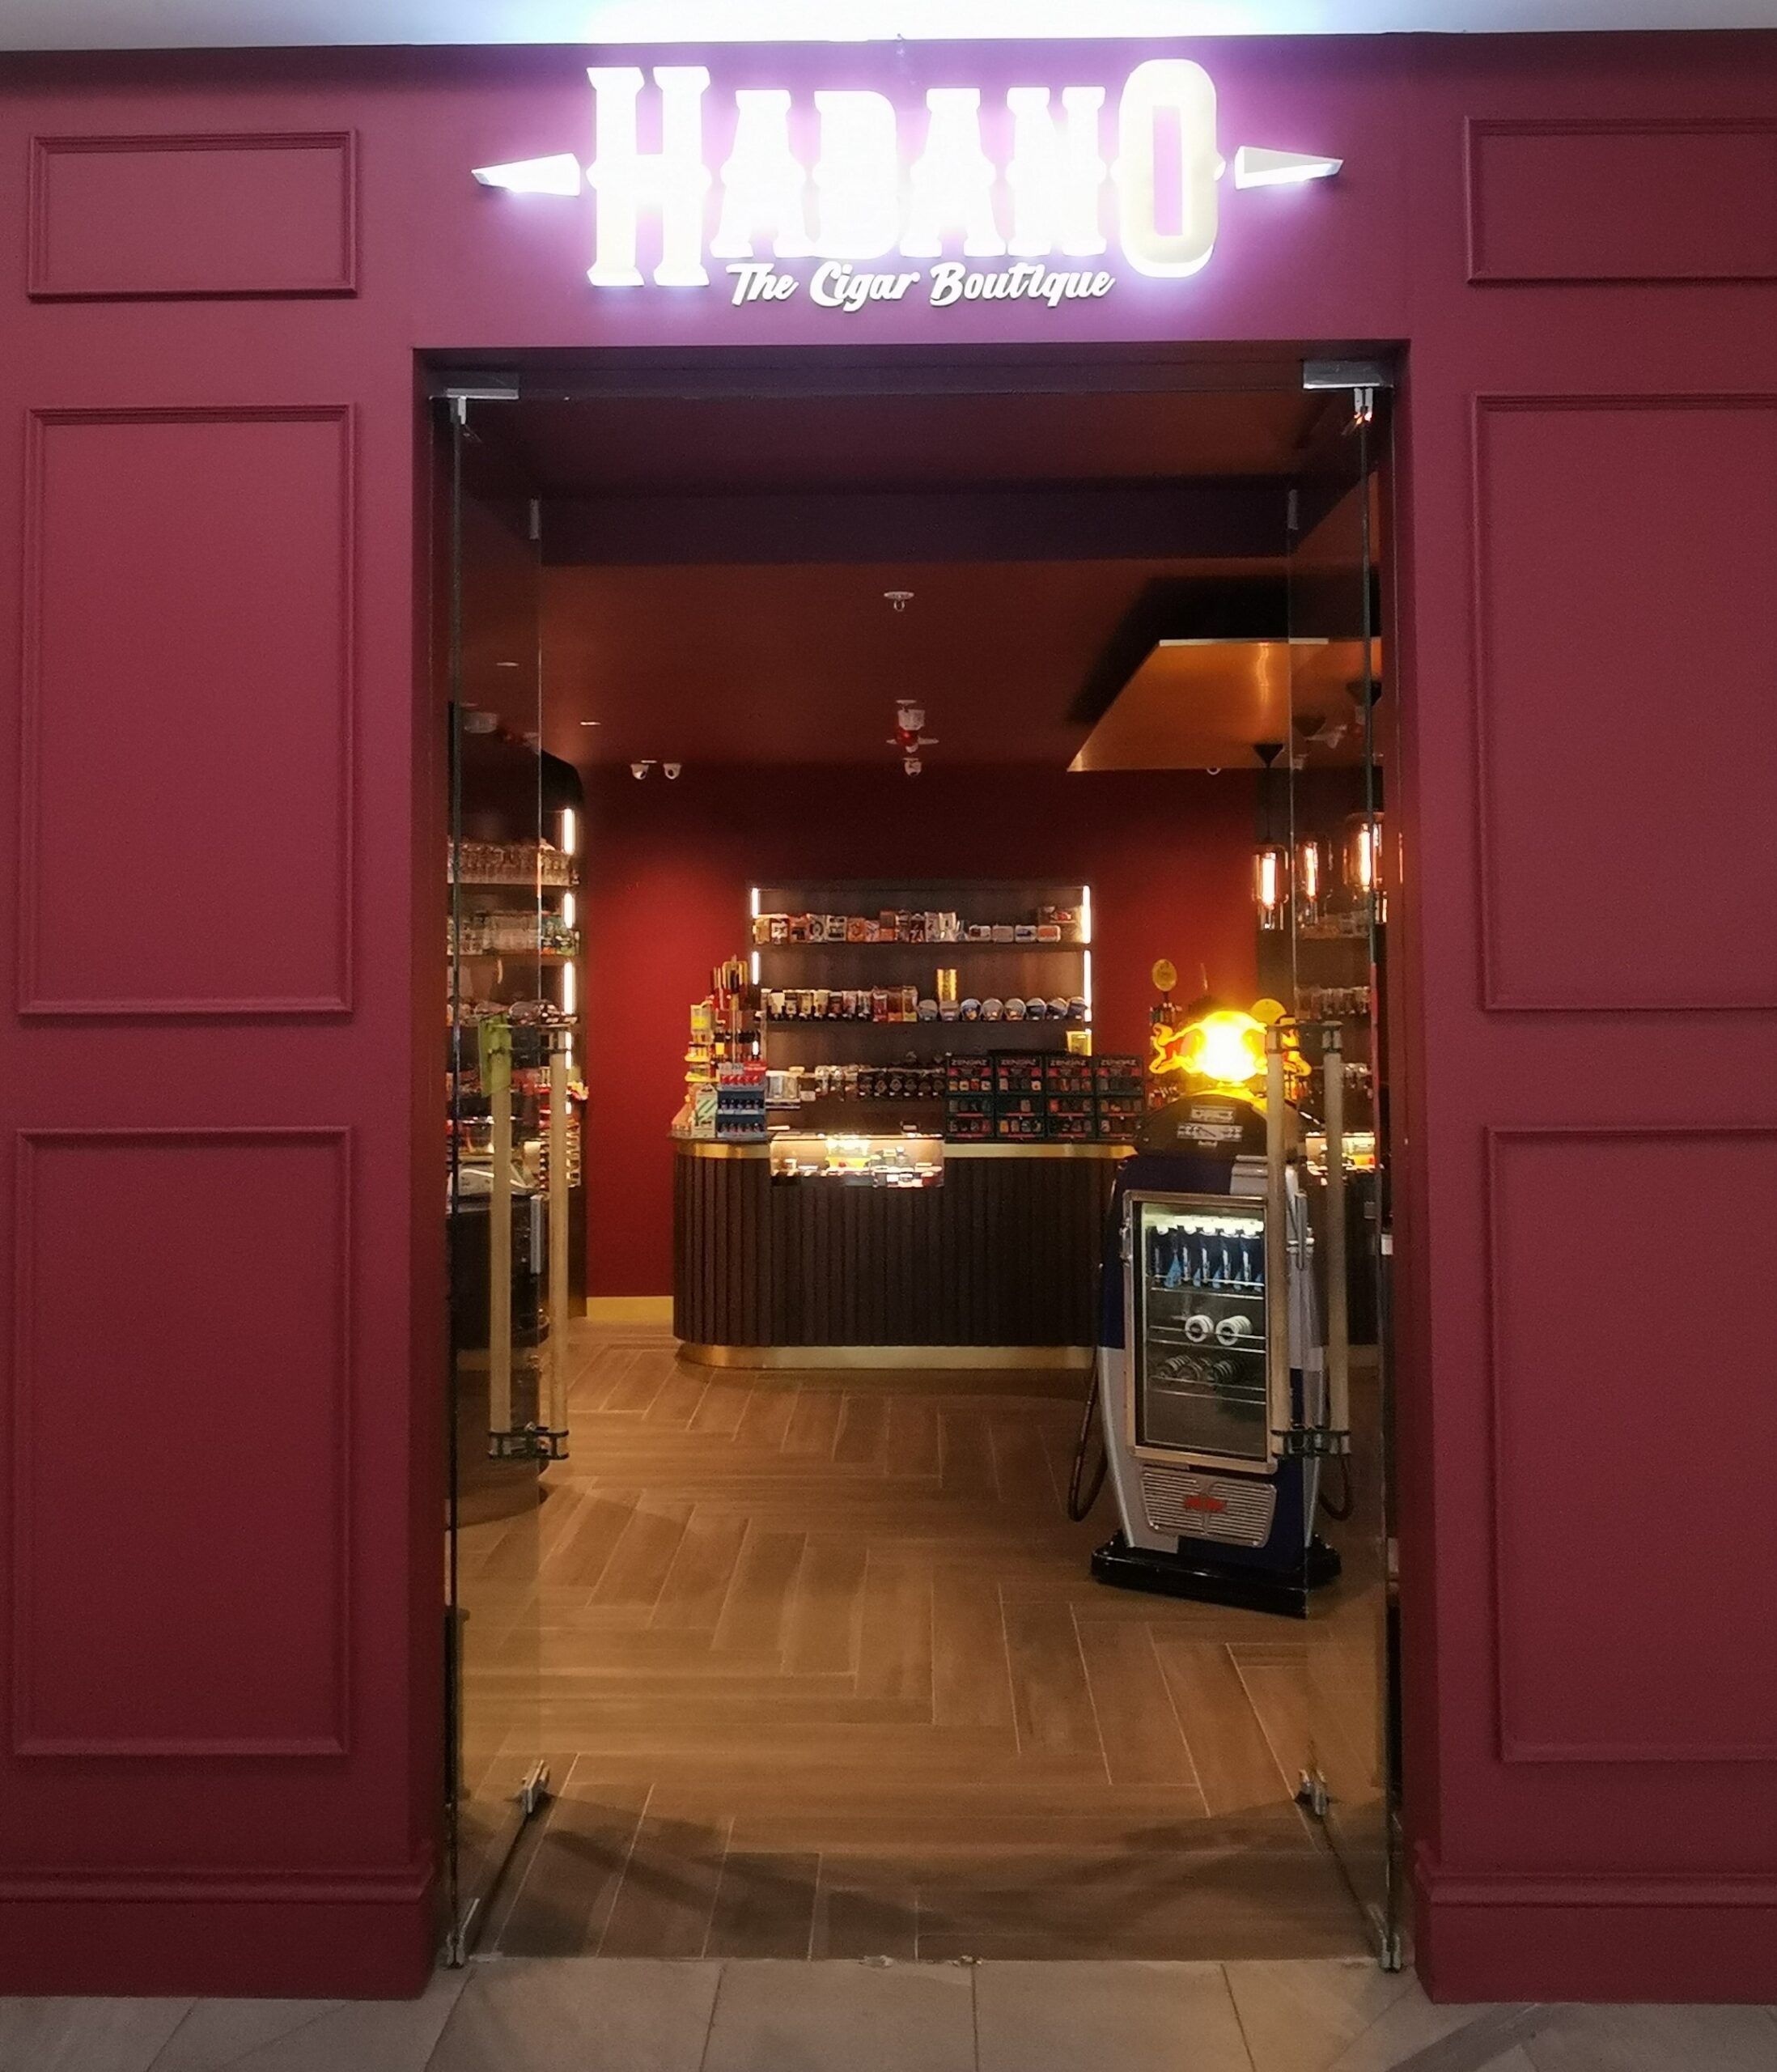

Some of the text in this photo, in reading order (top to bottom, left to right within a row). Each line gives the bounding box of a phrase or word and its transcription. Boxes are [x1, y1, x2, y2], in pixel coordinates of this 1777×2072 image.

[586, 58, 1225, 287] HABANO
[725, 261, 1115, 312] The Cigar Boutique
